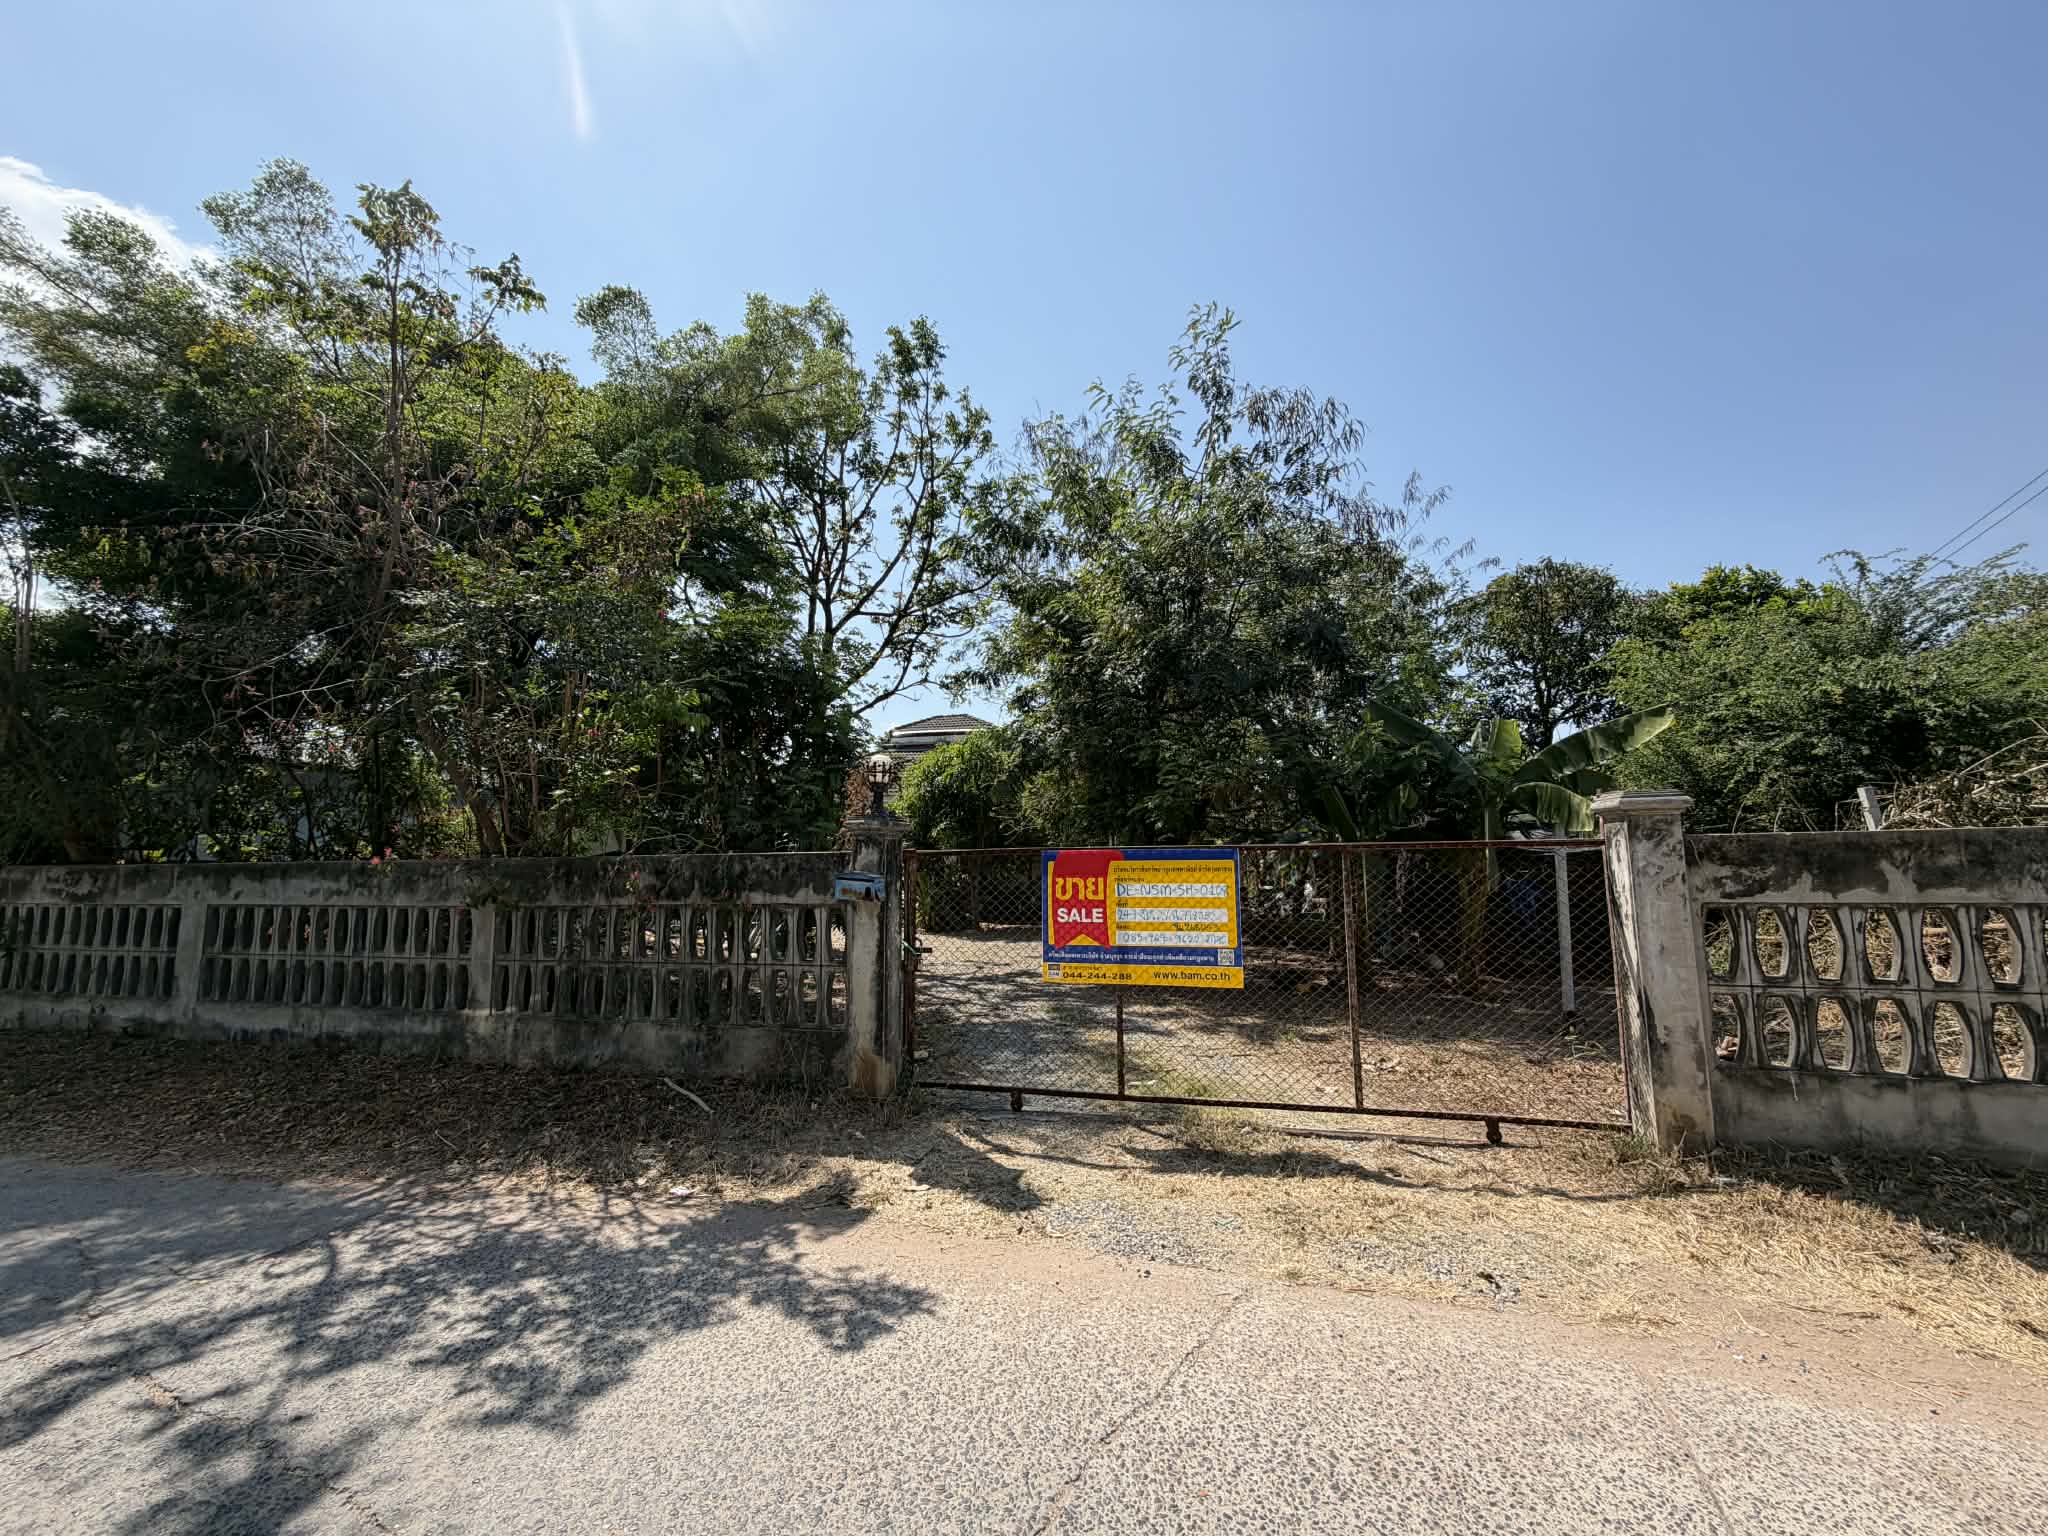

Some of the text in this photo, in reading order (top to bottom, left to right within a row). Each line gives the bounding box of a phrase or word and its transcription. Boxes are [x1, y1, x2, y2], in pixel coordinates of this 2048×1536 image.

[1055, 876, 1105, 901] ขาย
[1057, 907, 1104, 923] SALE
[1062, 971, 1133, 981] 044-244-288
[1153, 970, 1231, 981] www.bam.co.th
